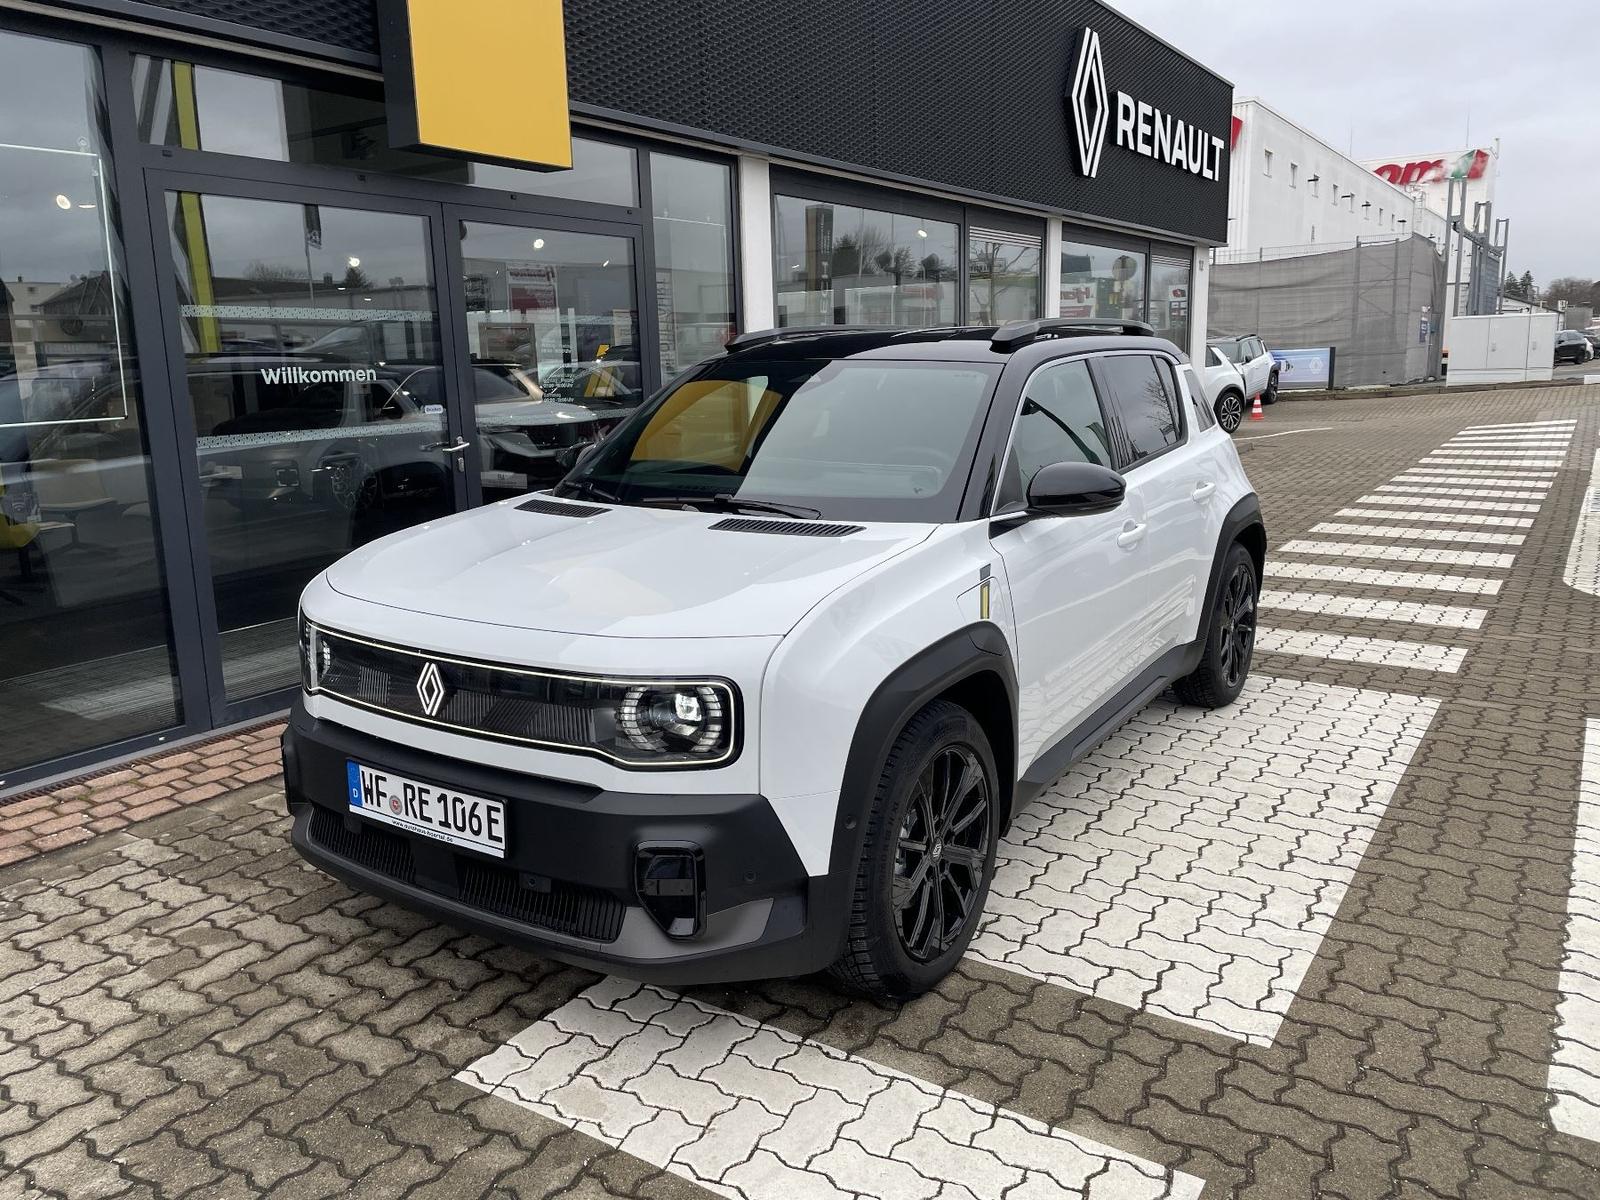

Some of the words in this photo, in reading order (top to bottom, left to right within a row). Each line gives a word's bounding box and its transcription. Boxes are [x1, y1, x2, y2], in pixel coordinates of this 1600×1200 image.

[1117, 90, 1225, 182] RENAULT
[260, 366, 377, 385] Willkommen
[361, 770, 388, 808] WF
